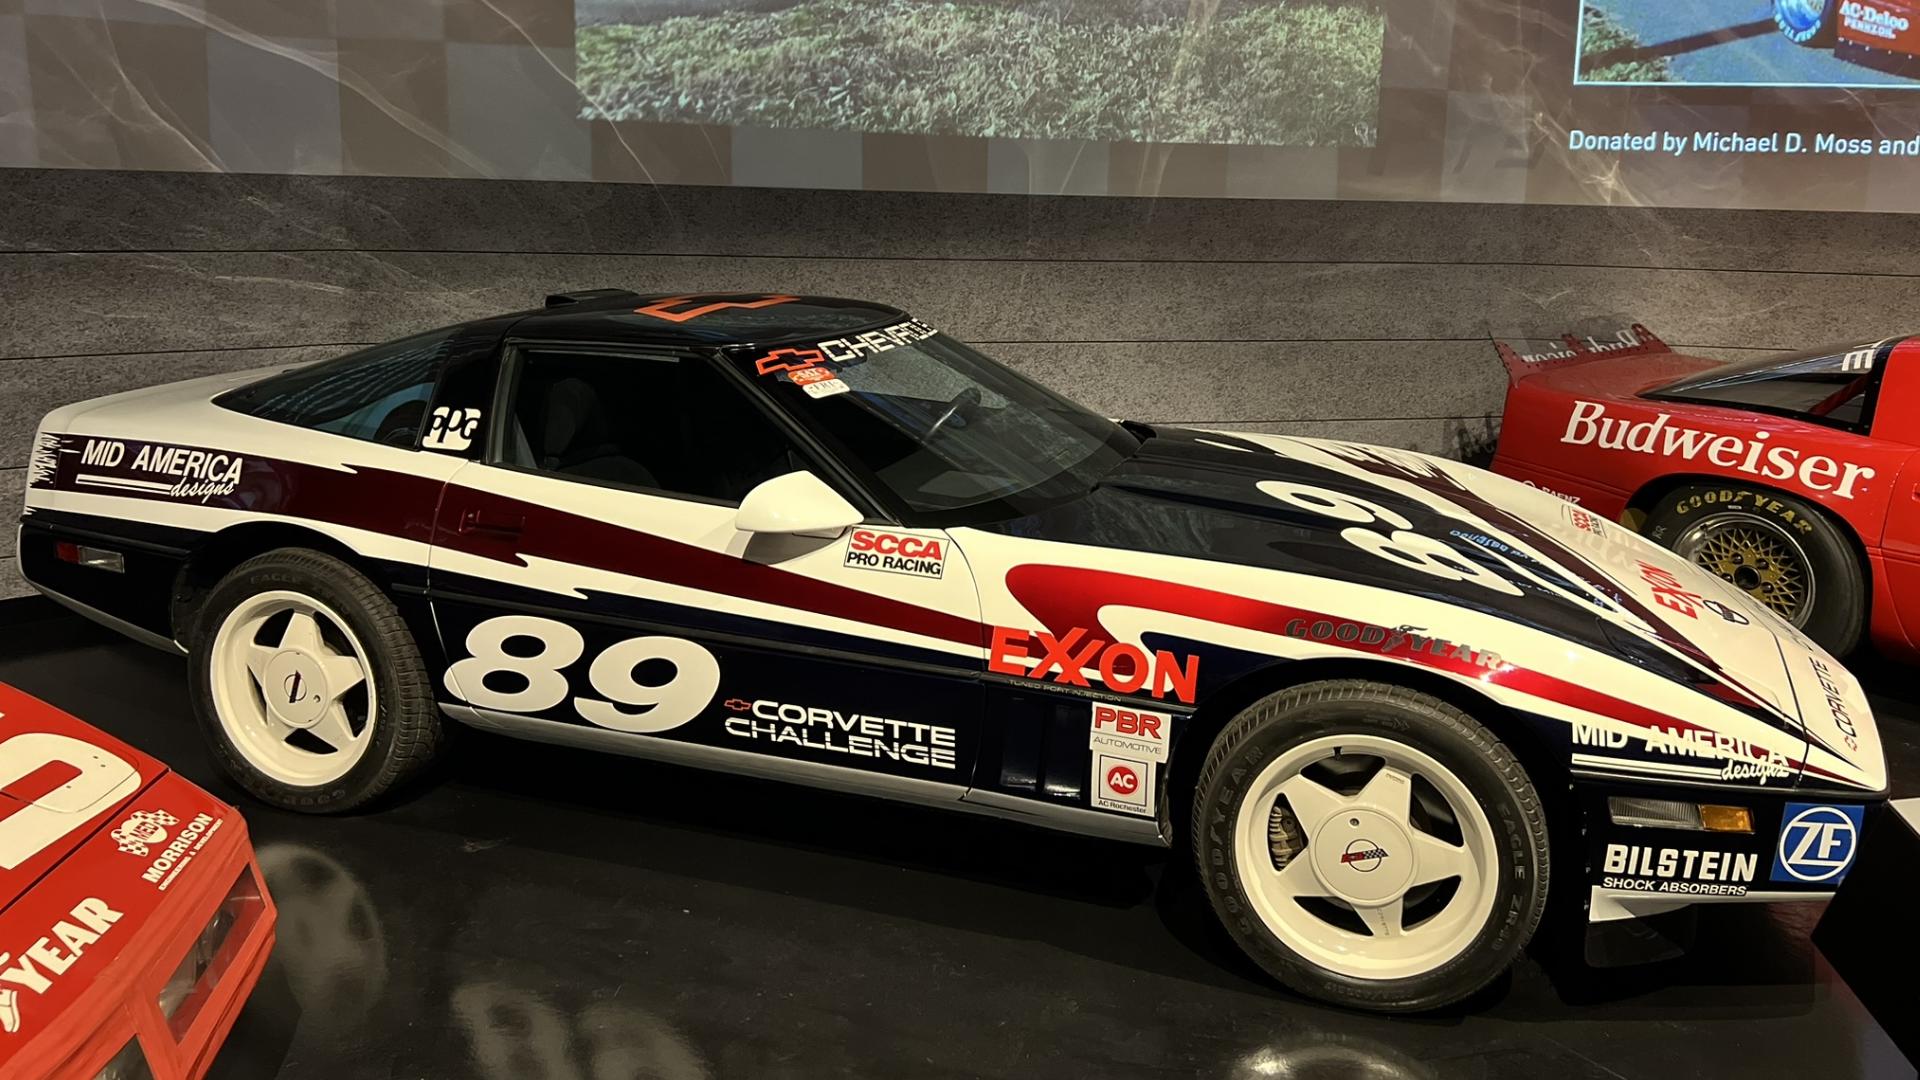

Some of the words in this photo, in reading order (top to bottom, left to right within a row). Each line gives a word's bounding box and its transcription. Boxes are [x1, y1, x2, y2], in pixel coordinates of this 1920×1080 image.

[1569, 130, 1657, 152] Donated
[1663, 133, 1688, 156] by
[1693, 130, 1778, 154] Michael
[1785, 133, 1808, 154] D.
[1815, 134, 1872, 155] Moss
[1879, 136, 1920, 156] and
[81, 439, 126, 468] MID
[131, 445, 244, 485] AMERICA
[1560, 400, 1876, 500] Budweiser
[170, 476, 236, 504] designs
[846, 552, 879, 566] PRO
[882, 556, 942, 575] RACING
[850, 531, 942, 560] SCCA
[988, 625, 1200, 704] EXXON
[1285, 618, 1505, 671] GOODYEAR
[443, 615, 720, 733] 89
[724, 717, 956, 769] CHALLENGE
[752, 700, 956, 747] CORVETTE
[1093, 736, 1162, 755] AUTOMOTIVE
[1094, 706, 1162, 739] PBR
[1571, 721, 1629, 749] MID
[1645, 725, 1790, 775] AMERICA
[1110, 771, 1136, 788] AC
[1098, 799, 1110, 808] AC
[1110, 801, 1147, 815] Rochester
[141, 812, 214, 884] MORRISON
[1603, 844, 1758, 882] BILSTEIN
[1786, 821, 1853, 867] ZF
[1603, 876, 1658, 891] SHOCK
[1659, 881, 1747, 896] ABSORBERS
[0, 897, 124, 994] YEAR
